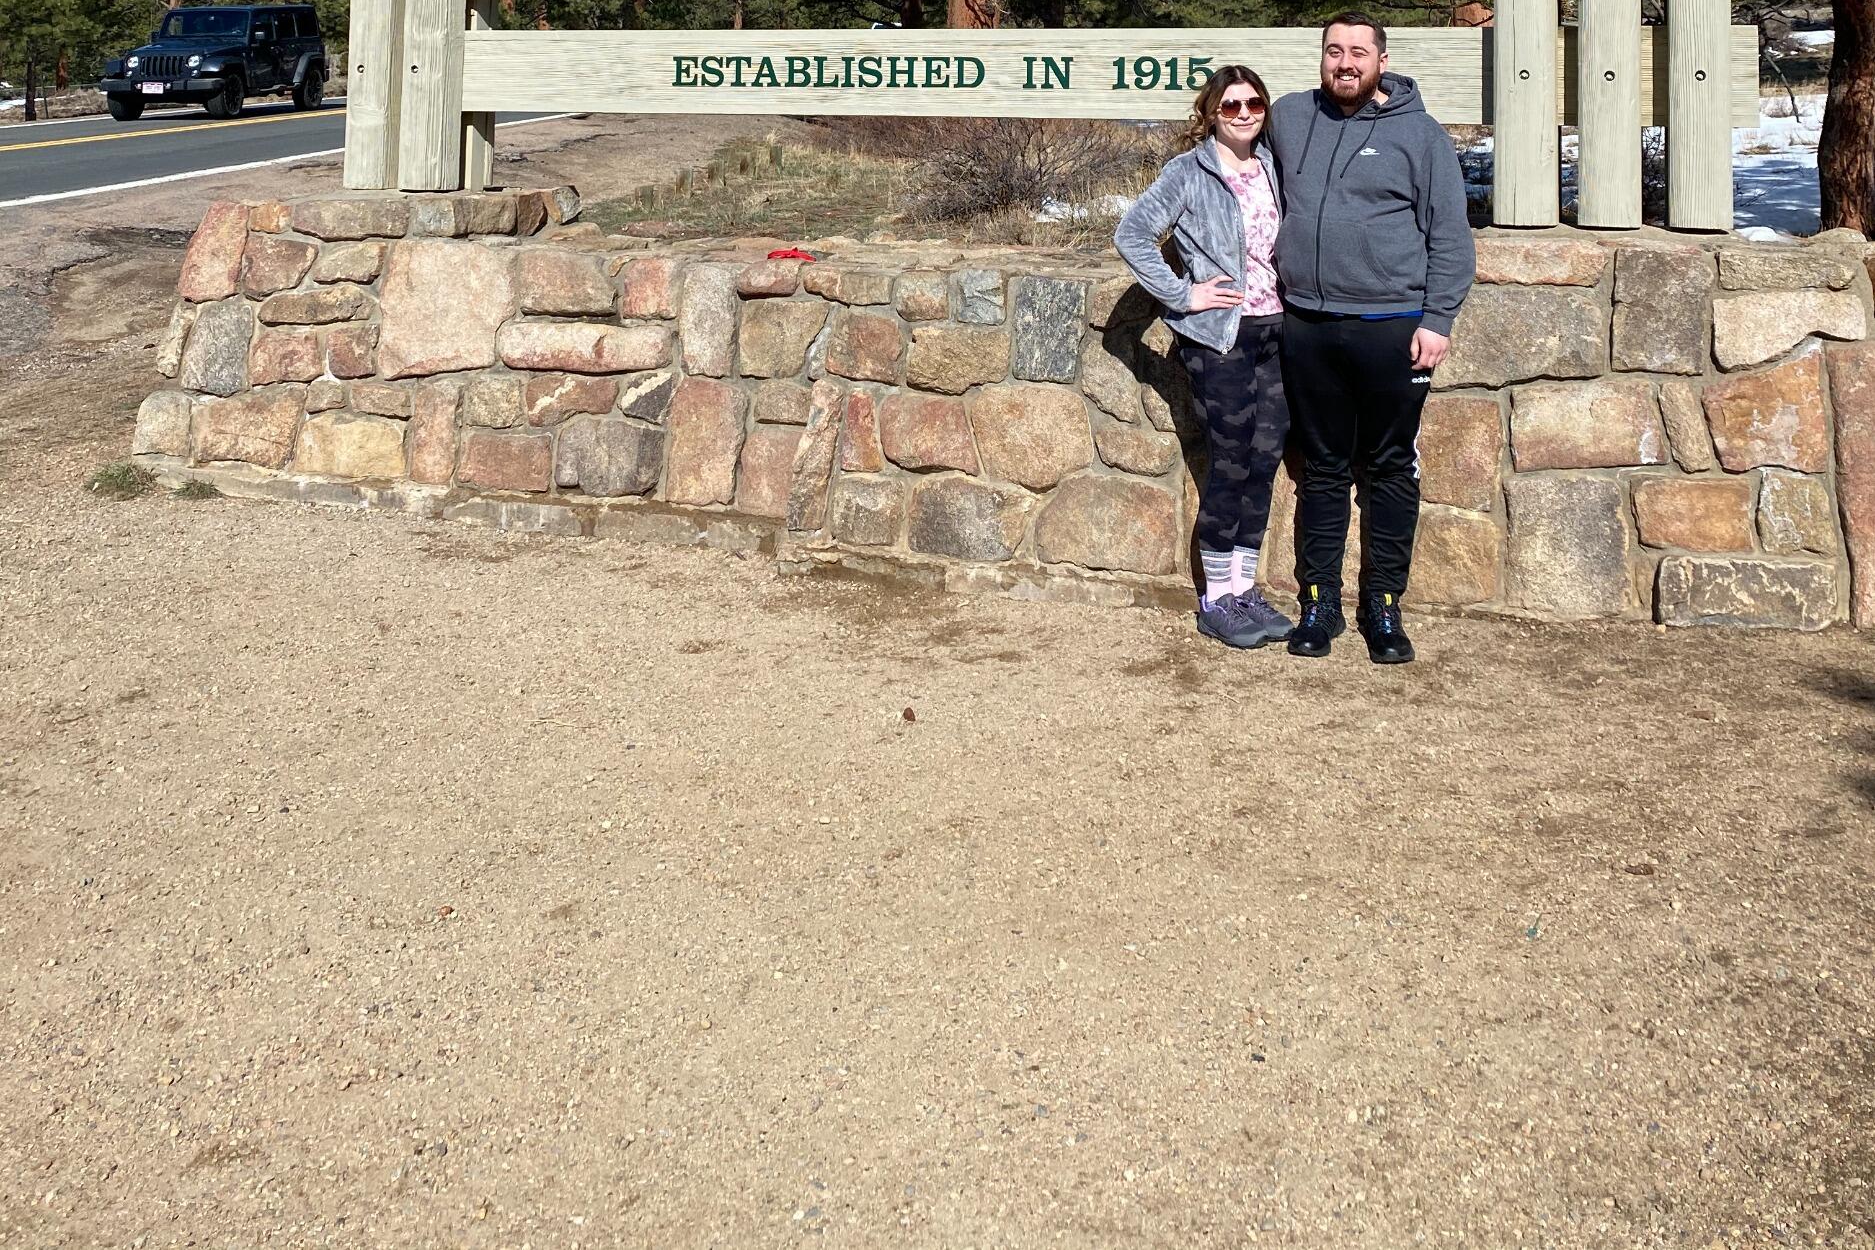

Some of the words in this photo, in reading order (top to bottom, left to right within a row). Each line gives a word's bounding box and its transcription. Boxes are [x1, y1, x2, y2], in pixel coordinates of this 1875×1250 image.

[672, 56, 985, 88] ESTABLISHED
[1023, 56, 1074, 89] IN
[1112, 56, 1214, 91] 1915
